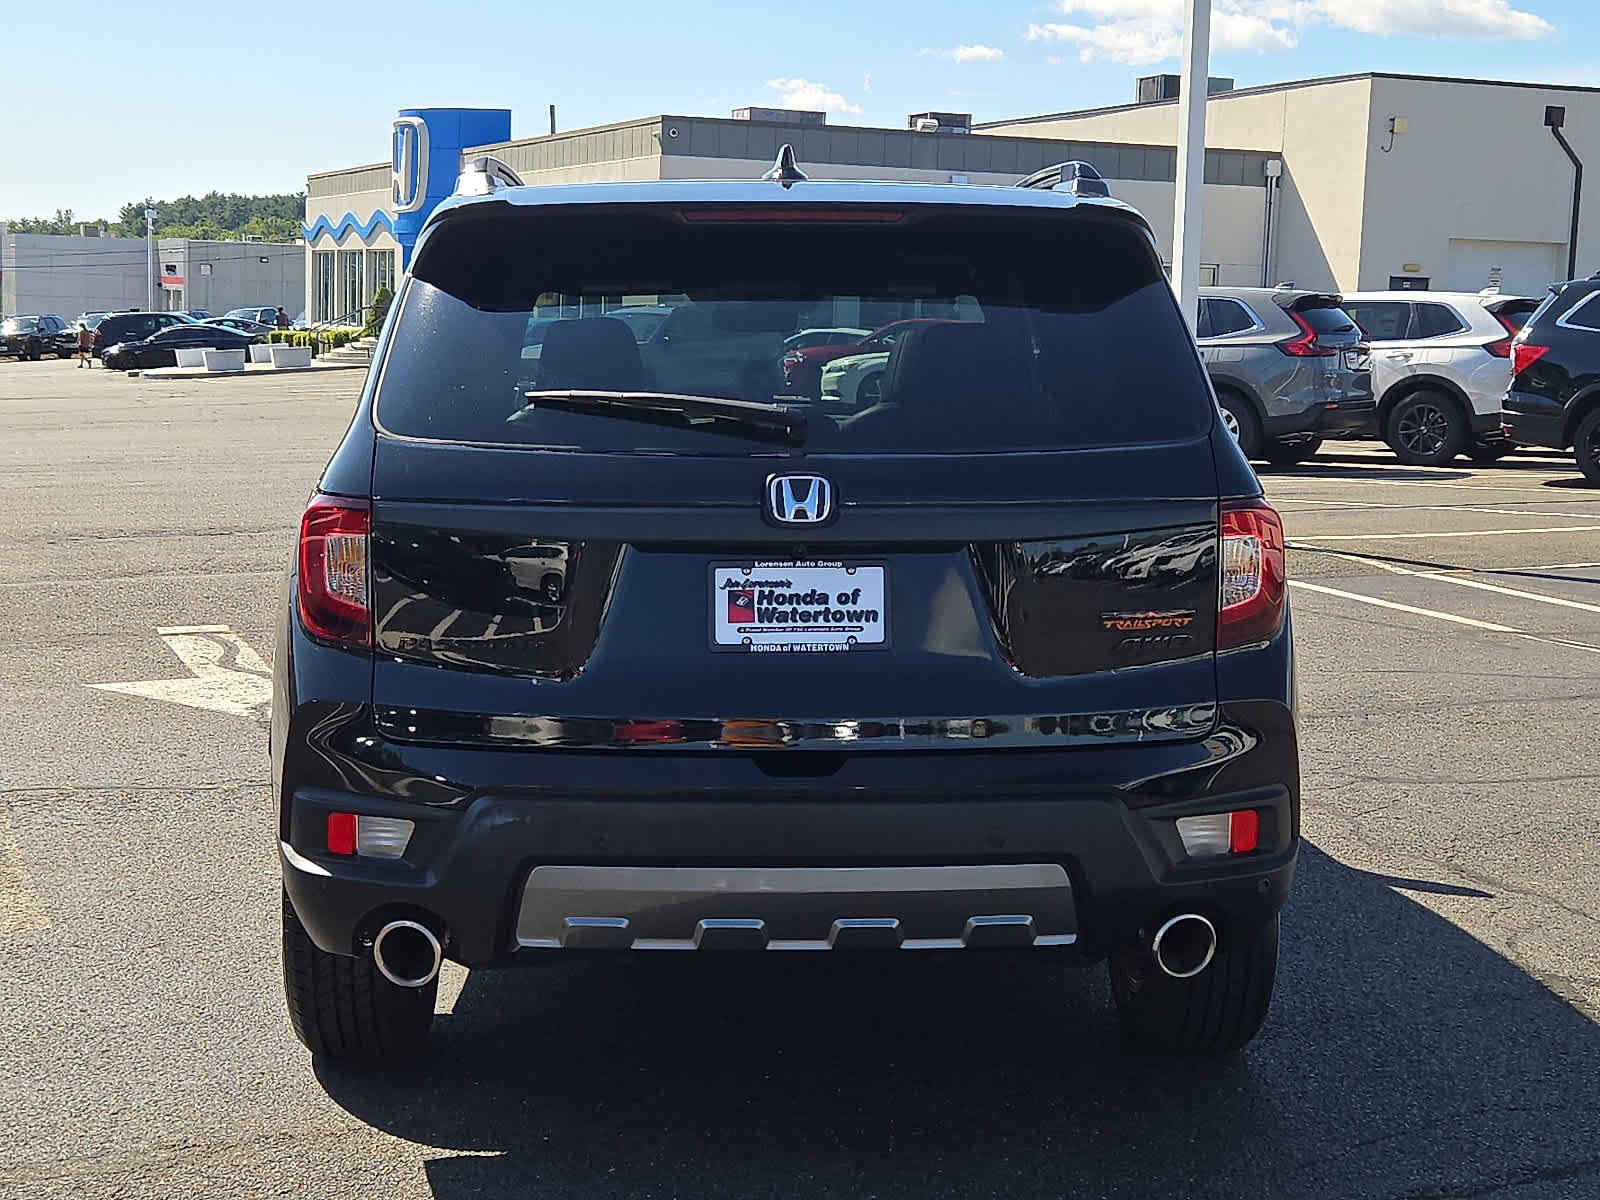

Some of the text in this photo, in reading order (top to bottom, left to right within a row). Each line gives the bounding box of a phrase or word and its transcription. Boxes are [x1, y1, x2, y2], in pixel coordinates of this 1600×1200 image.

[817, 561, 843, 569] Group
[756, 588, 862, 606] Honda of
[756, 606, 879, 624] Watertown
[1103, 617, 1193, 631] TRAILSPORT
[750, 642, 849, 652] HONDA of WATERTOWN
